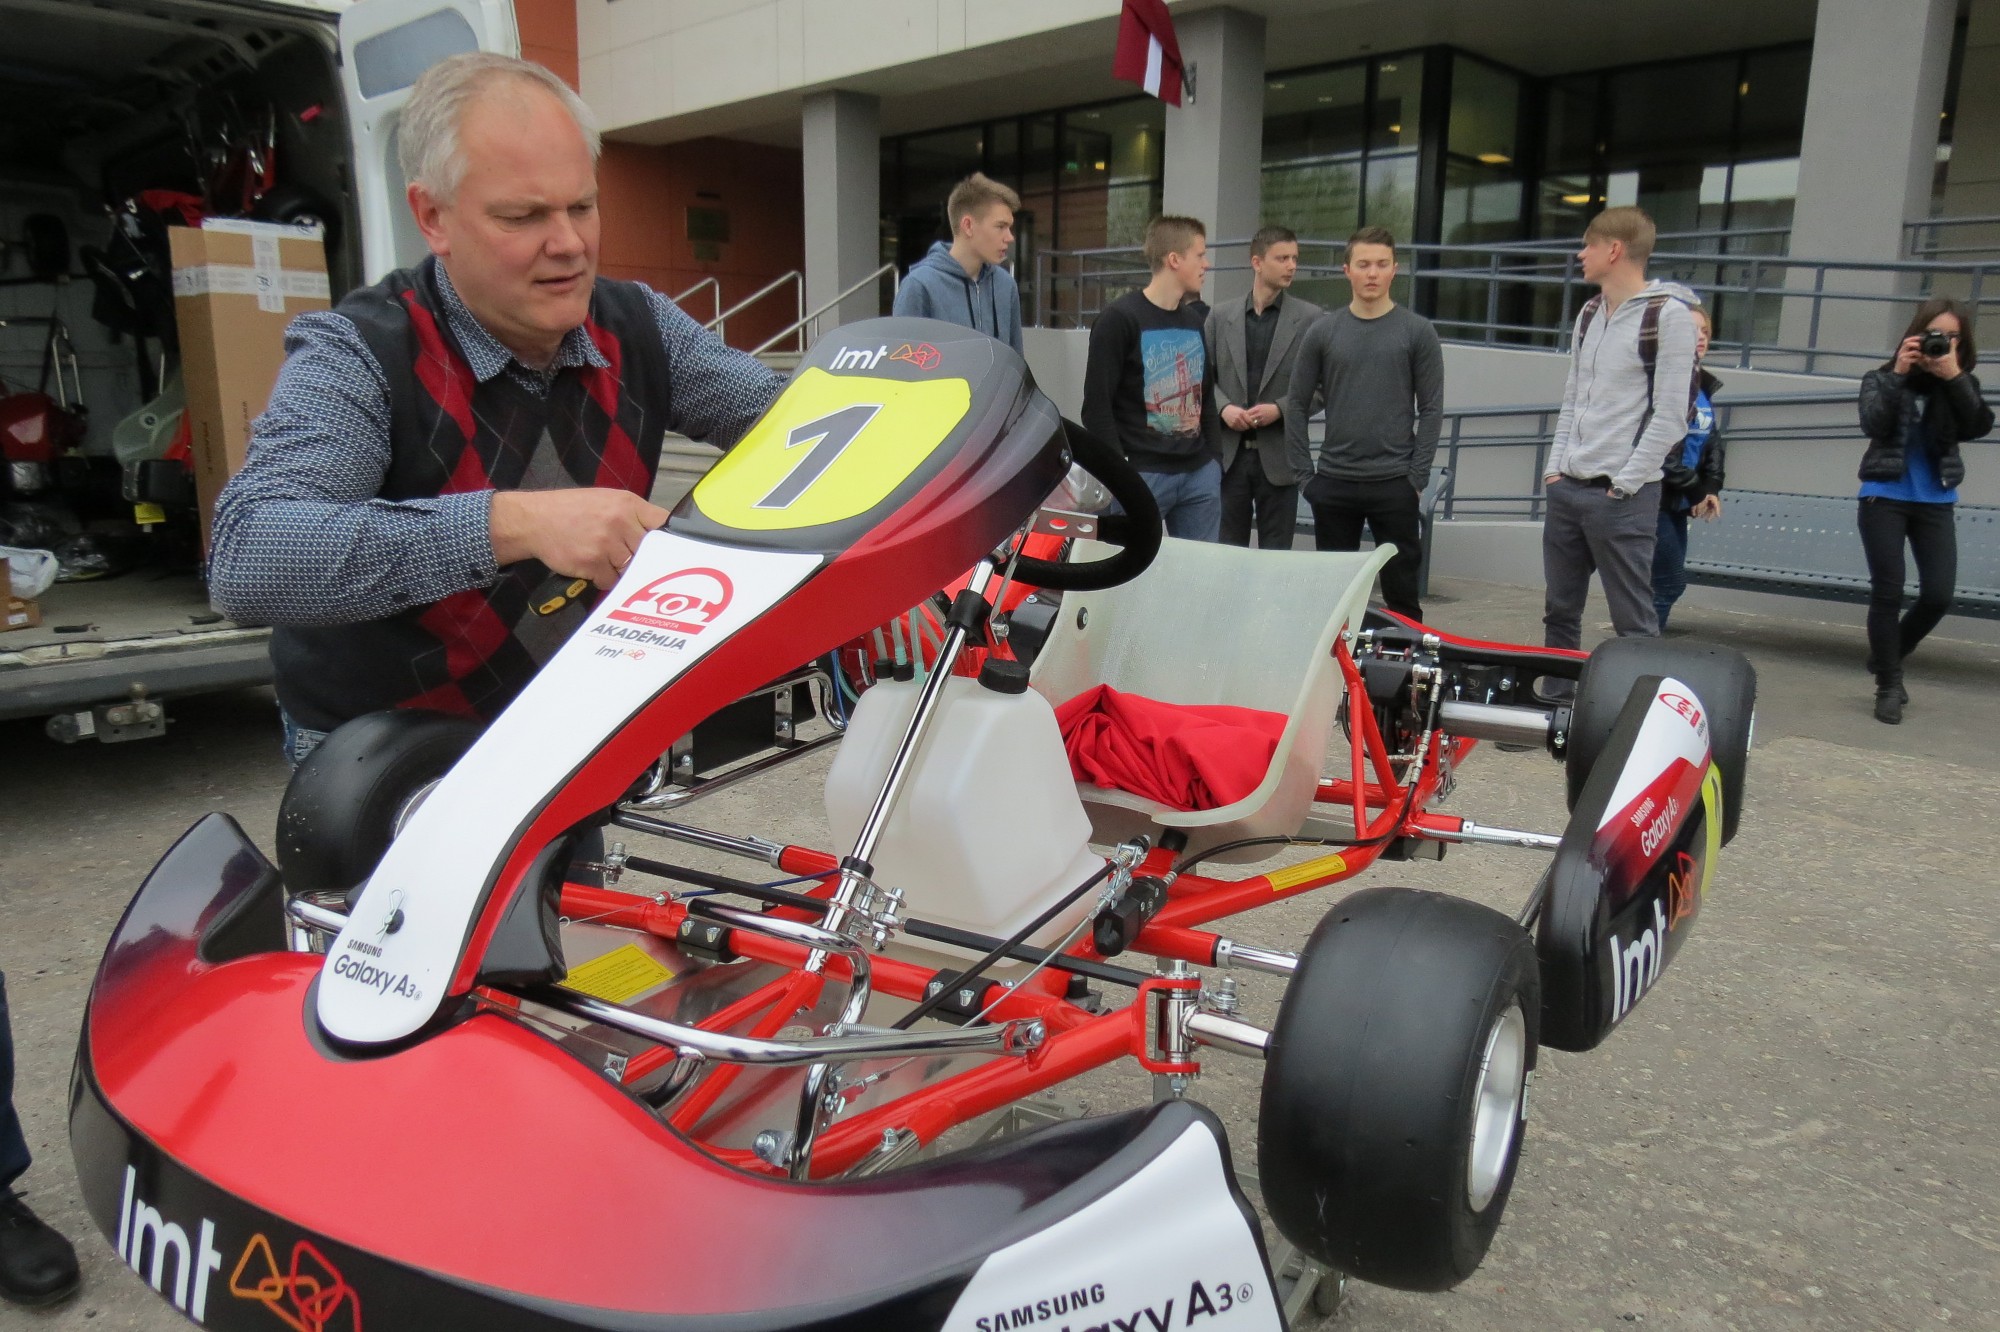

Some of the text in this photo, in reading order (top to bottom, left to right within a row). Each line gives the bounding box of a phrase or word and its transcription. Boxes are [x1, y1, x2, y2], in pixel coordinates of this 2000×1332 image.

[829, 345, 888, 371] lmt
[750, 403, 885, 510] 1
[590, 623, 688, 650] AKADĒMIJA
[630, 614, 680, 630] AUTOSPORTA
[594, 645, 624, 659] lmt
[1630, 796, 1655, 828] SAMSUNG
[1641, 804, 1671, 858] Galaxy
[346, 938, 383, 958] SAMSUNG
[1610, 898, 1666, 1024] lmt
[333, 953, 397, 996] Galaxy
[117, 1163, 222, 1324] lmt
[975, 1282, 1106, 1332] SAMSUNG
